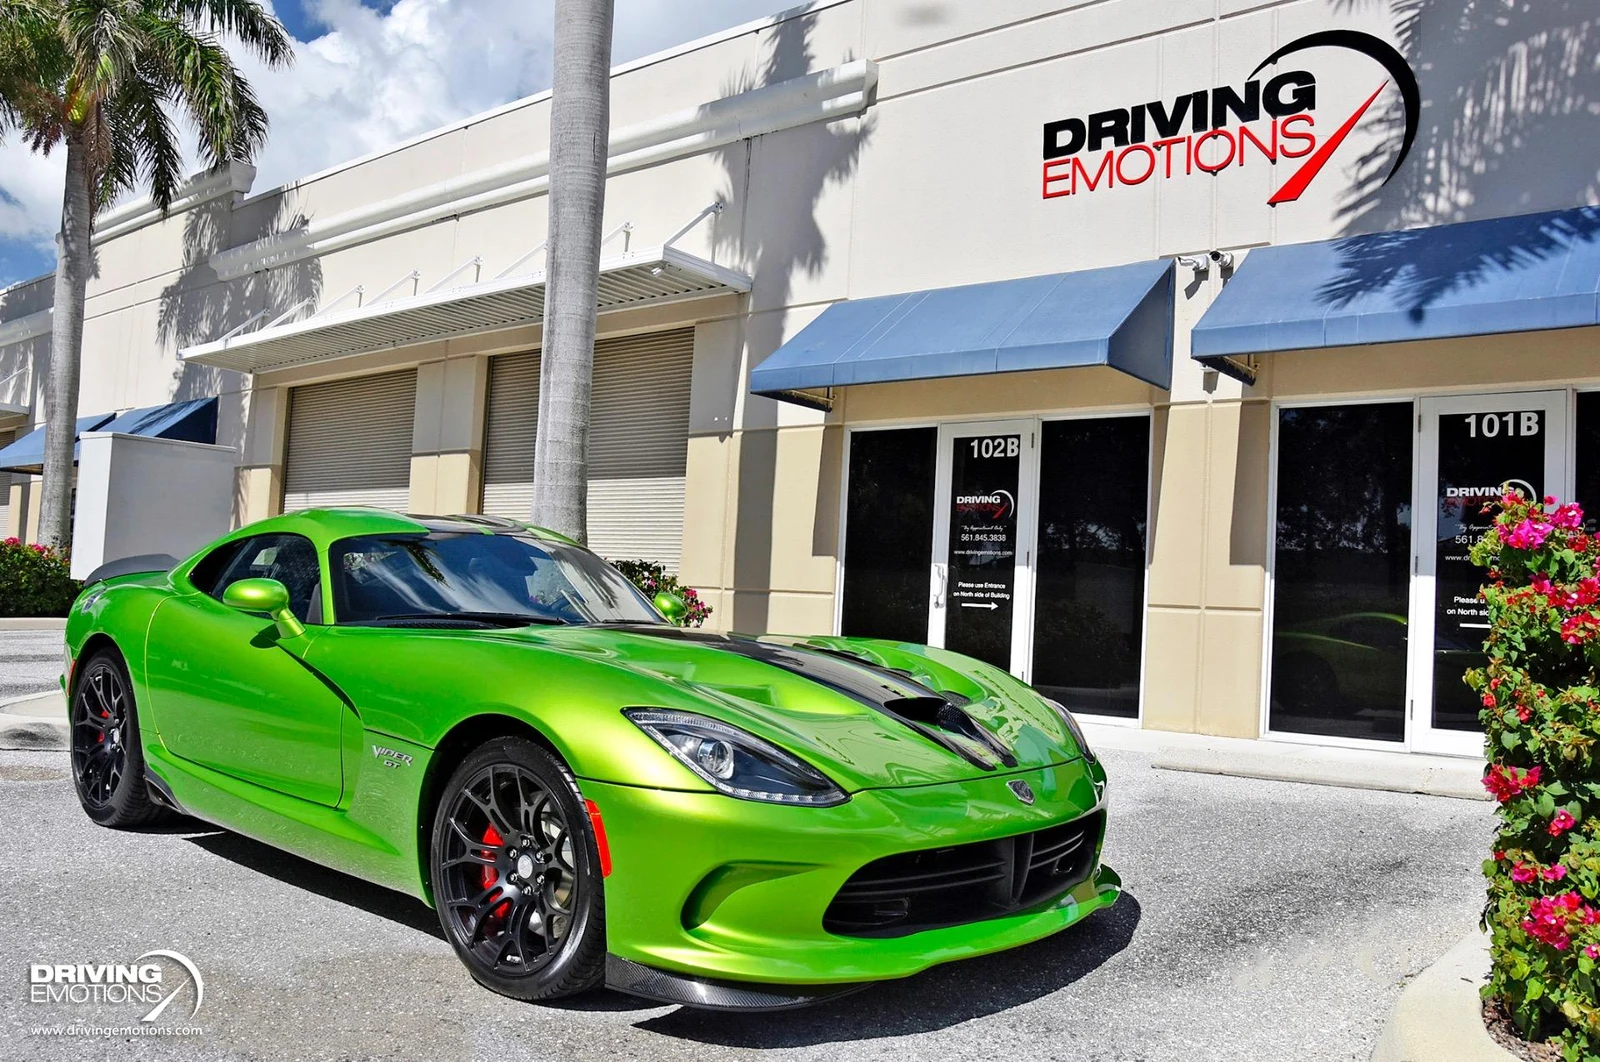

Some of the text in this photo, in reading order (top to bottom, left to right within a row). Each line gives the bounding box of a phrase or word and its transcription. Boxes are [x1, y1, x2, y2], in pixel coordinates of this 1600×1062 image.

[1043, 70, 1316, 160] DRIVING
[1043, 114, 1316, 199] EMOTIONS
[1464, 412, 1539, 438] 101B
[970, 438, 1019, 458] 102B
[956, 495, 1001, 504] DRIVING
[961, 533, 1007, 541] 561.845.3838
[953, 549, 1013, 557] www.drivingemotions.com
[958, 581, 974, 589] Please
[990, 592, 1010, 600] Building
[1454, 596, 1478, 604] Please
[372, 744, 414, 767] VIPER
[384, 759, 401, 768] GT
